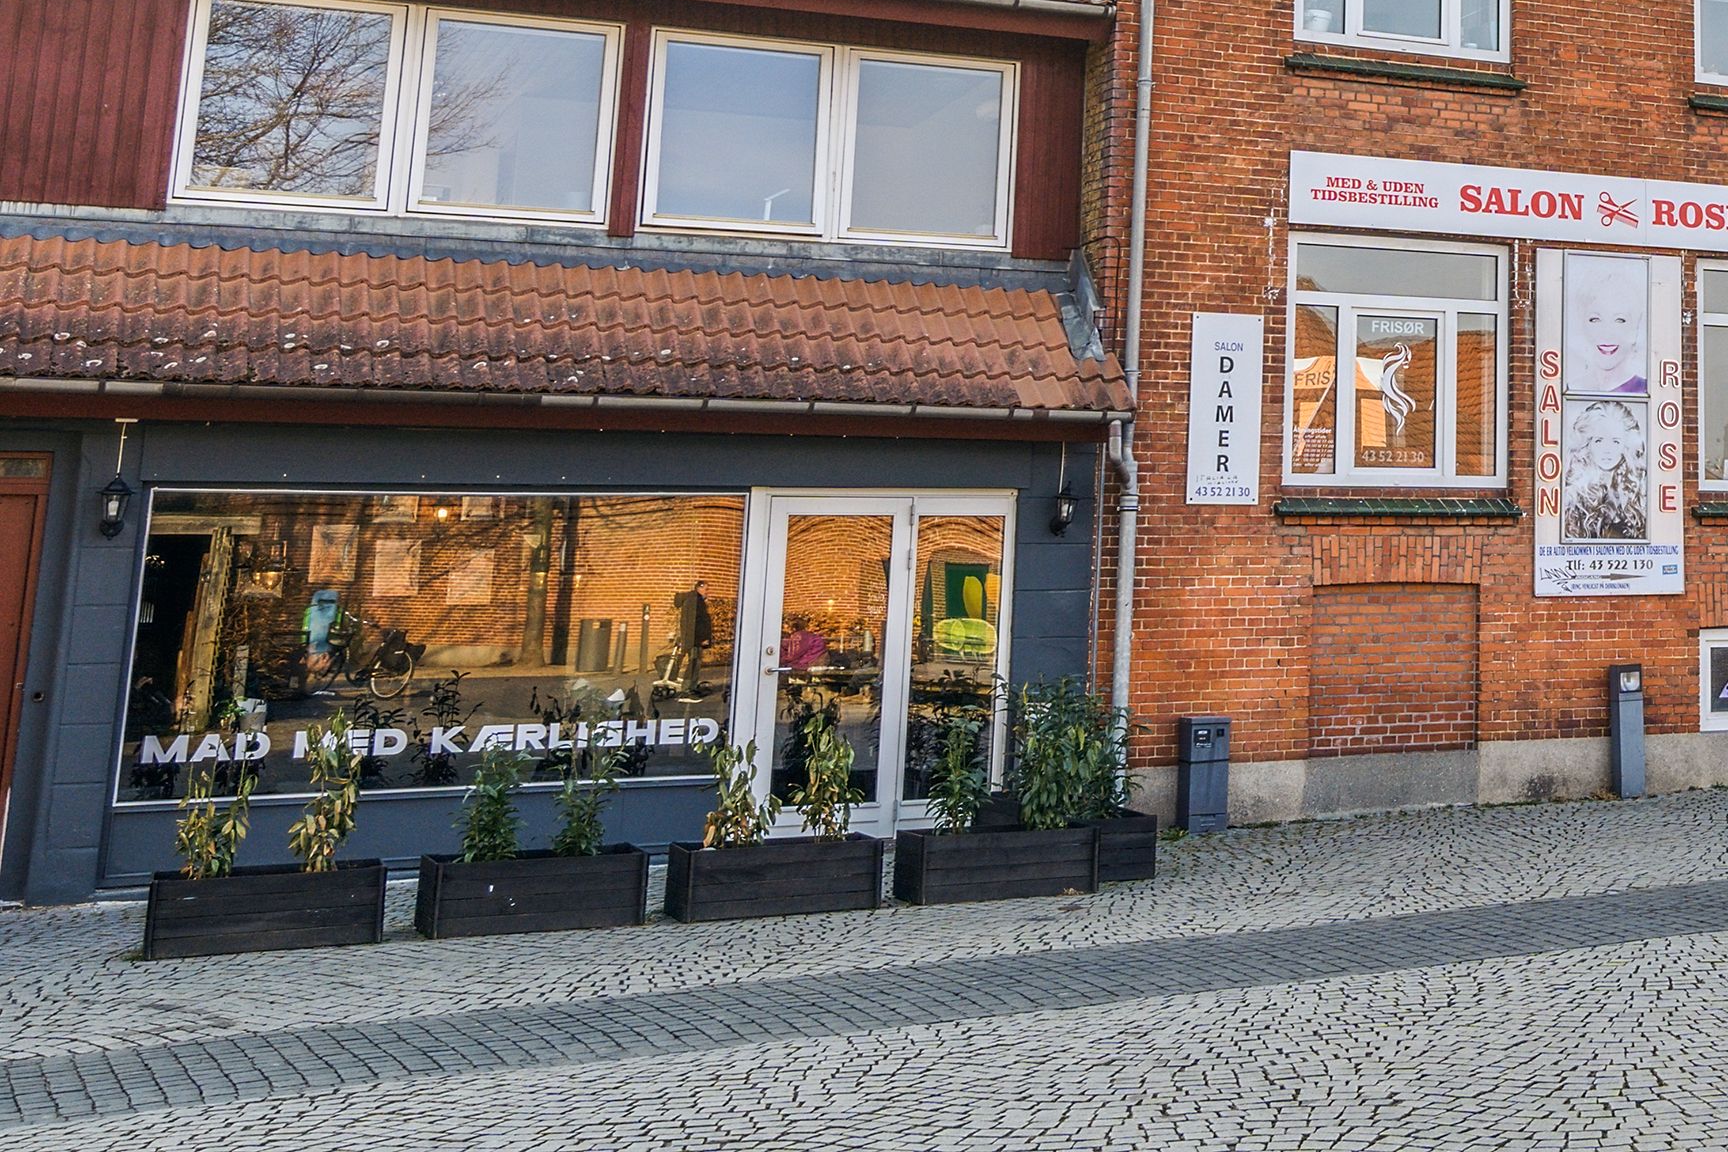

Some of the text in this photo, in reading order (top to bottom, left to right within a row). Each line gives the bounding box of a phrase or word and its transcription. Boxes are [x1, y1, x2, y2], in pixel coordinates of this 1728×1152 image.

[1326, 176, 1424, 194] MED & UDEN
[1310, 188, 1439, 209] TIDSBESTILLING
[1459, 184, 1585, 220] SALON
[1371, 320, 1424, 334] FRISØR
[1214, 342, 1243, 352] SALON
[1215, 356, 1235, 472] DAMER
[1538, 349, 1561, 517] SALON
[1658, 359, 1681, 514] ROSE
[1362, 450, 1425, 462] 43 52 21 30
[1195, 487, 1251, 497] 43 52 21 30
[1589, 559, 1603, 570] 43
[1607, 559, 1628, 570] 522
[1633, 559, 1654, 570] 130
[141, 717, 719, 764] MAD MED KÆRLIGHED
